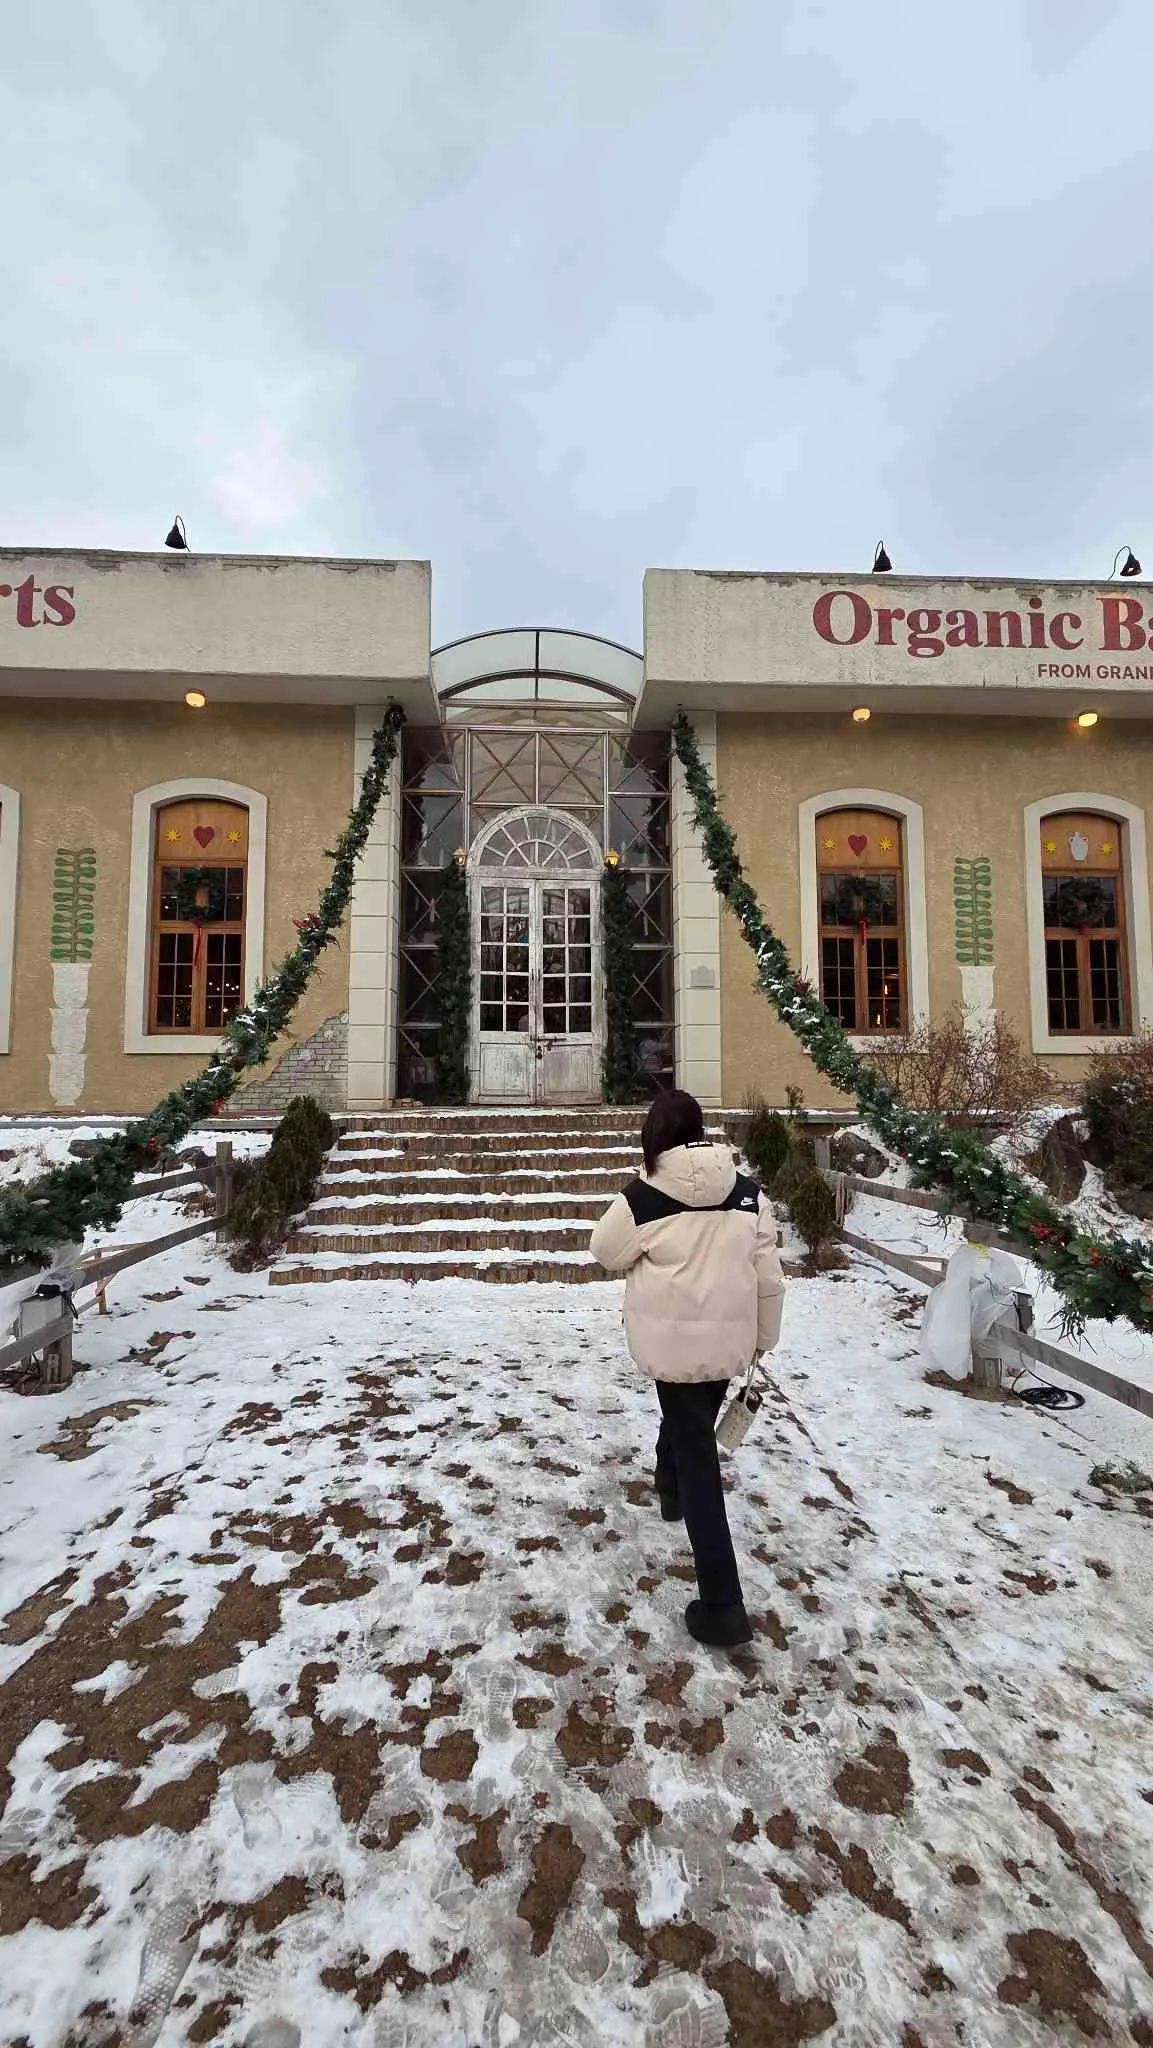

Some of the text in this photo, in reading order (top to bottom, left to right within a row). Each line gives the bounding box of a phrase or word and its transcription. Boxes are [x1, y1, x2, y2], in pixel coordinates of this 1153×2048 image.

[812, 590, 1153, 659] Organic B
[1038, 663, 1153, 680] FROM GRAN
